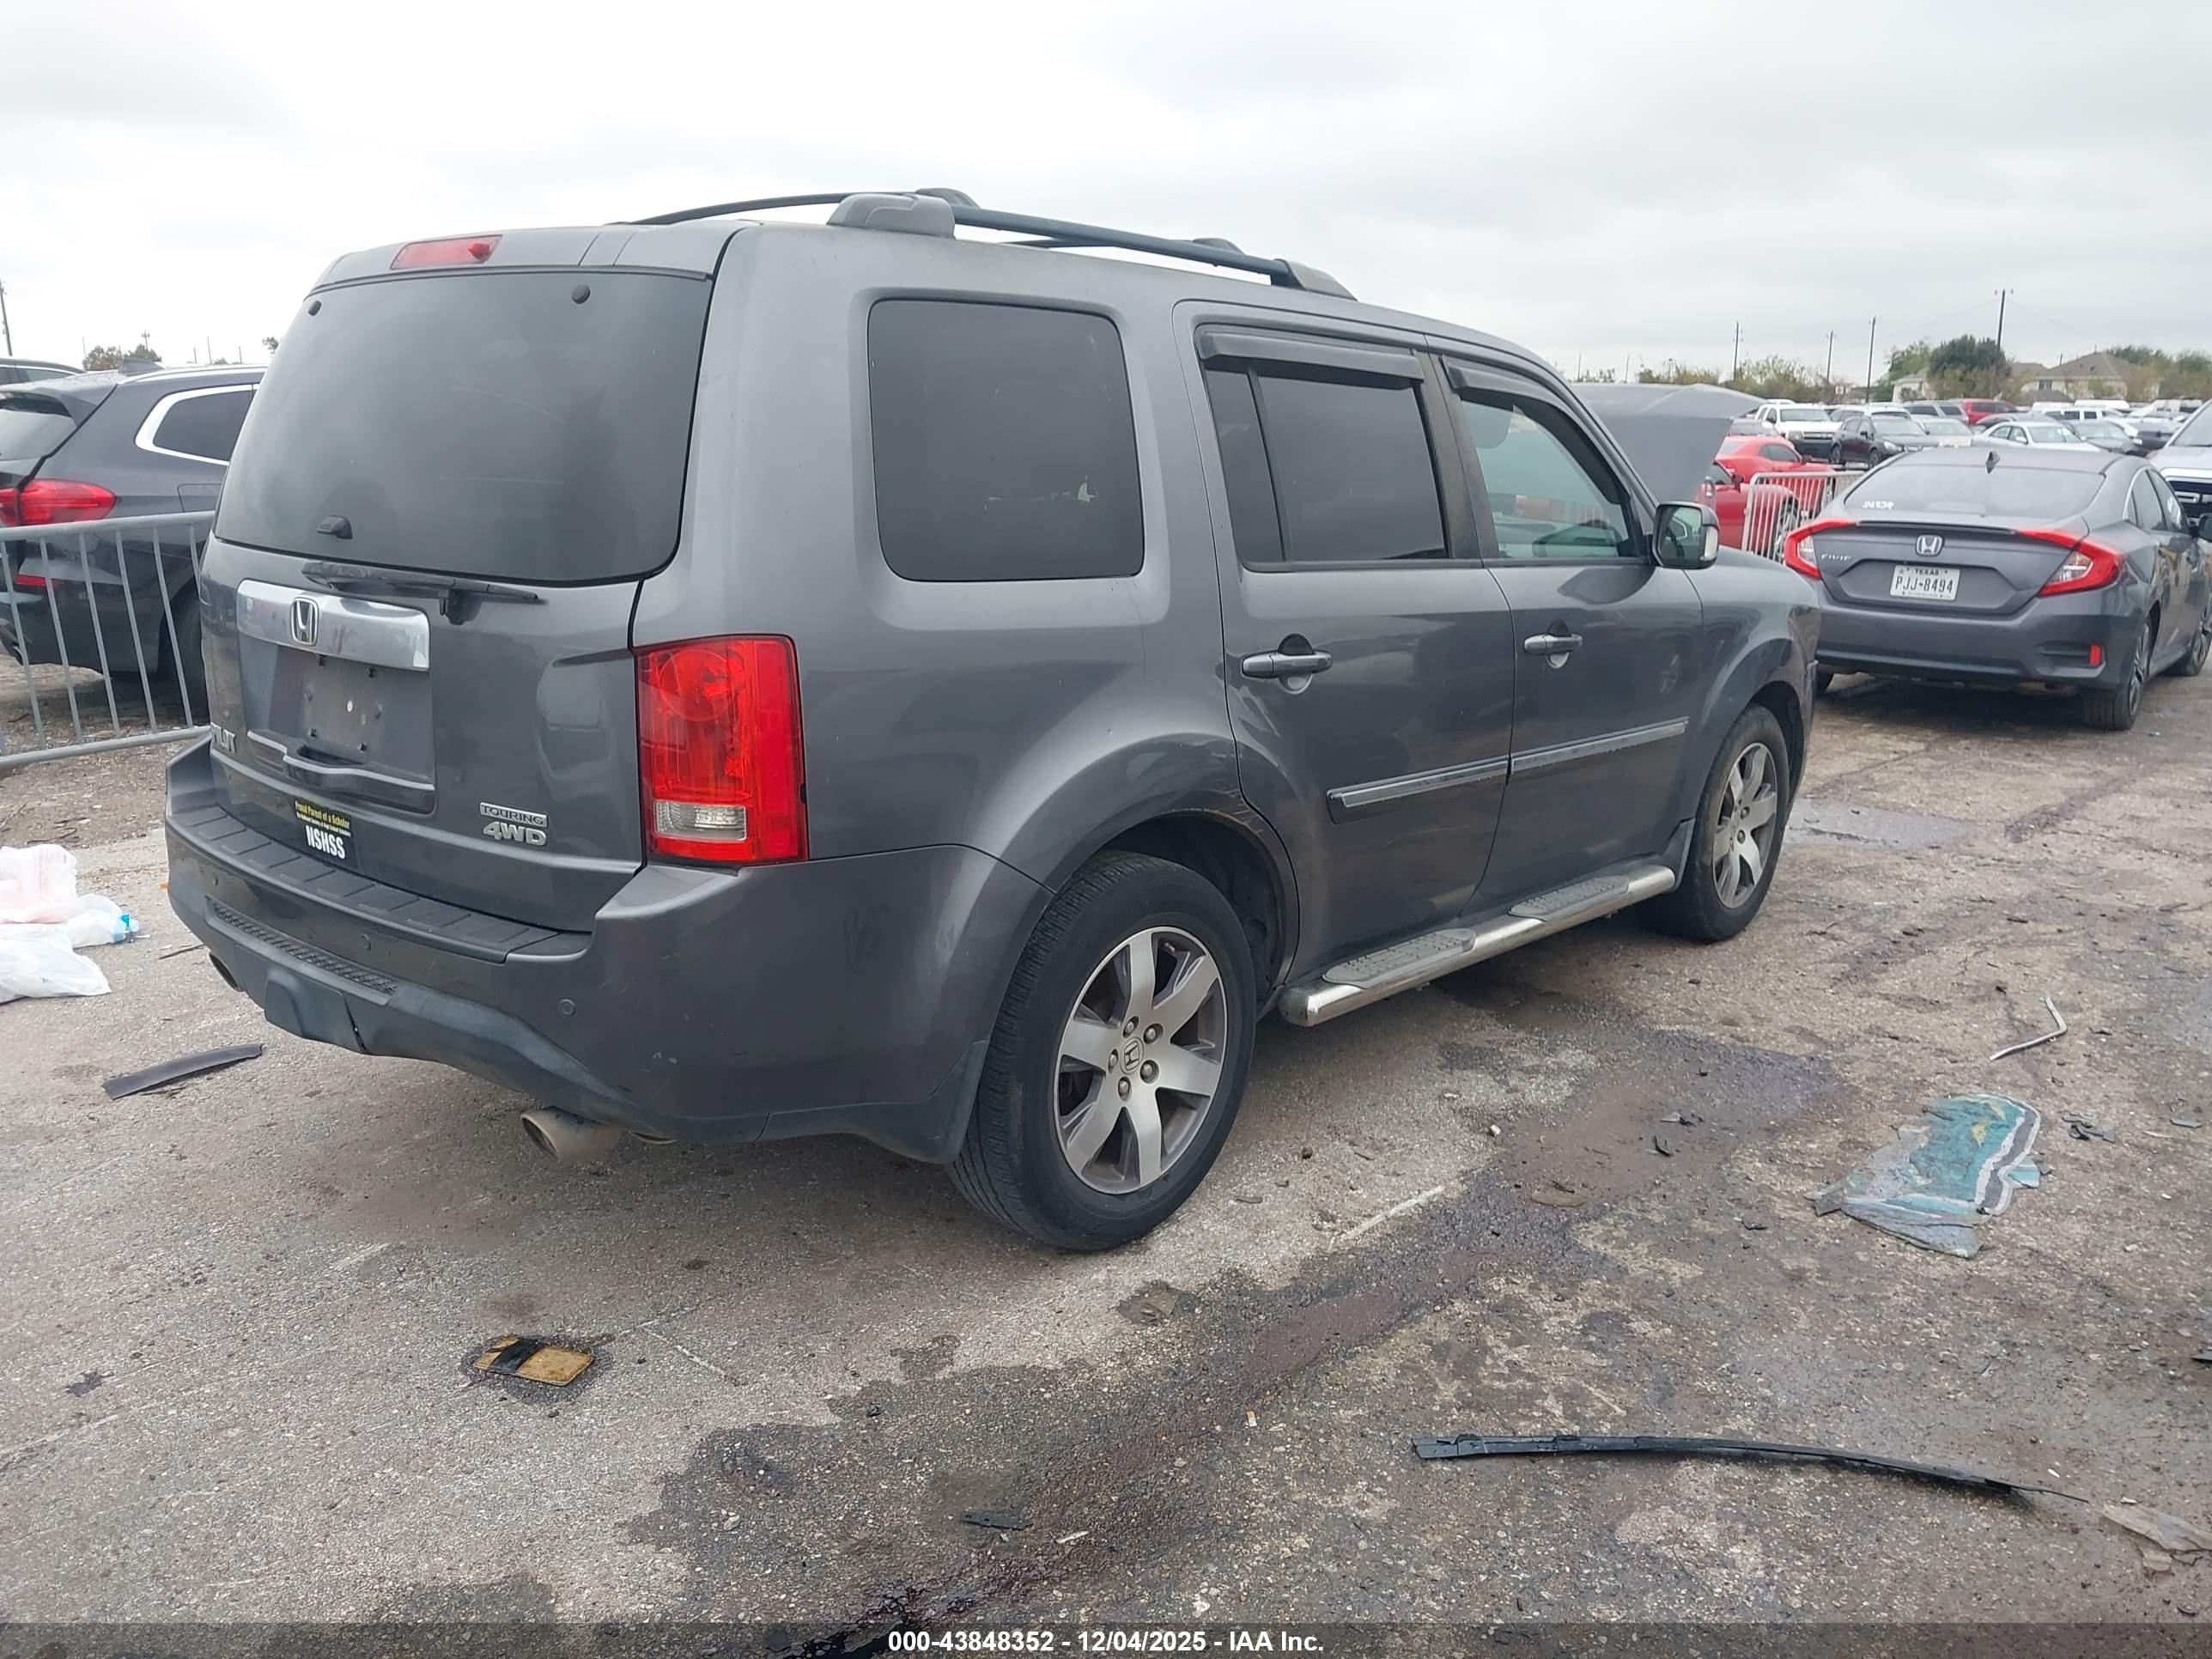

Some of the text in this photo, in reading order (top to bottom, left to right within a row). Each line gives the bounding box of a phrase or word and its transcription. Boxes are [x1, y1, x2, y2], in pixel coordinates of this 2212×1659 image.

[1915, 568, 1940, 576] TEXAS
[307, 805, 322, 820] Parent
[331, 814, 350, 830] Scholar
[482, 805, 544, 826] TOURING
[305, 824, 346, 860] NSHSS
[483, 820, 547, 847] 4WD
